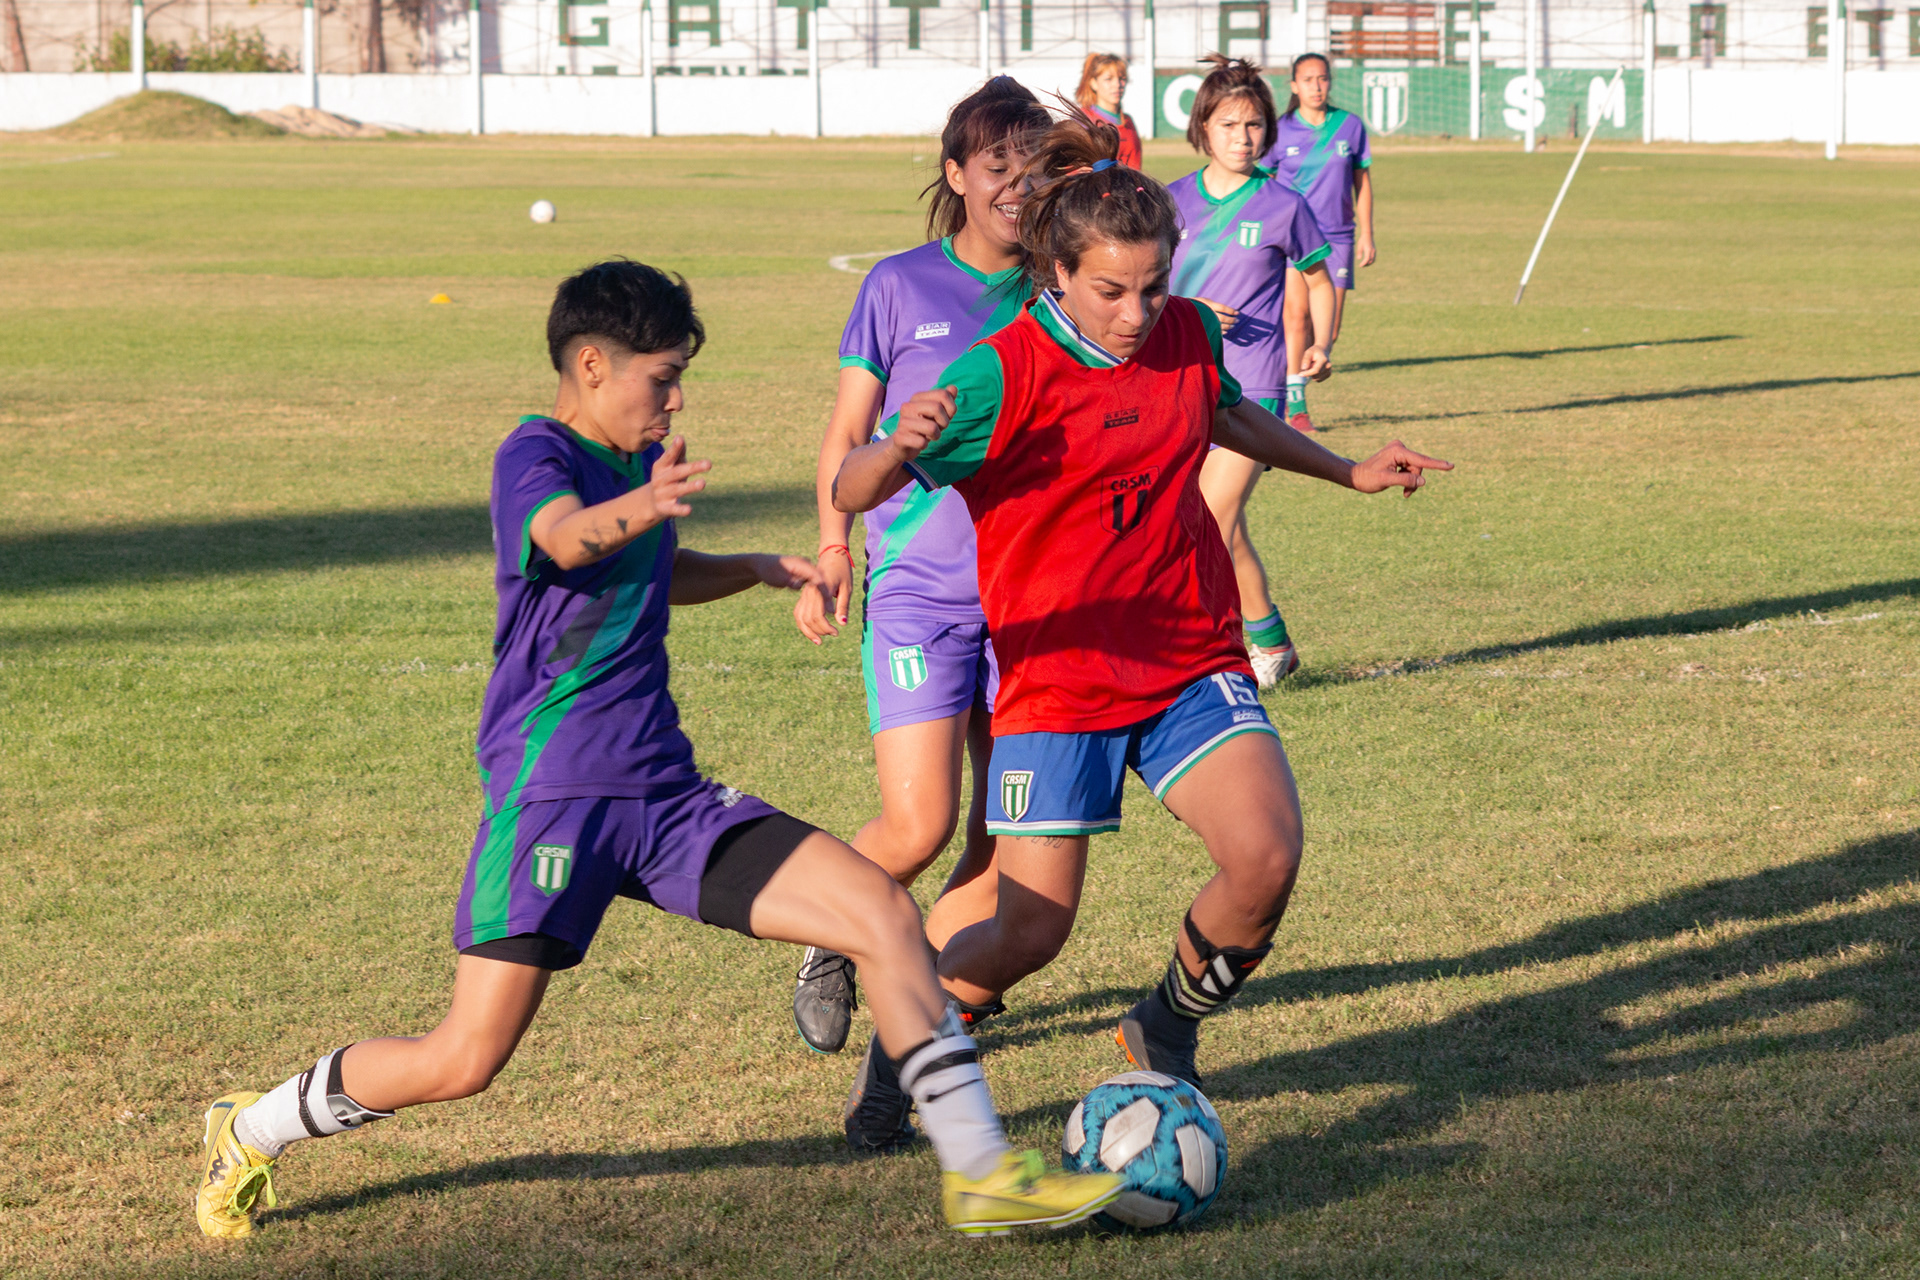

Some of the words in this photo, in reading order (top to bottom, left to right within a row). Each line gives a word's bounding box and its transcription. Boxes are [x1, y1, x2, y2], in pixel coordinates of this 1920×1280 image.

[559, 0, 1032, 51] GATTI
[1110, 472, 1152, 492] CASM
[893, 647, 918, 660] CASM
[1211, 672, 1259, 706] 15
[1005, 774, 1027, 785] CASM
